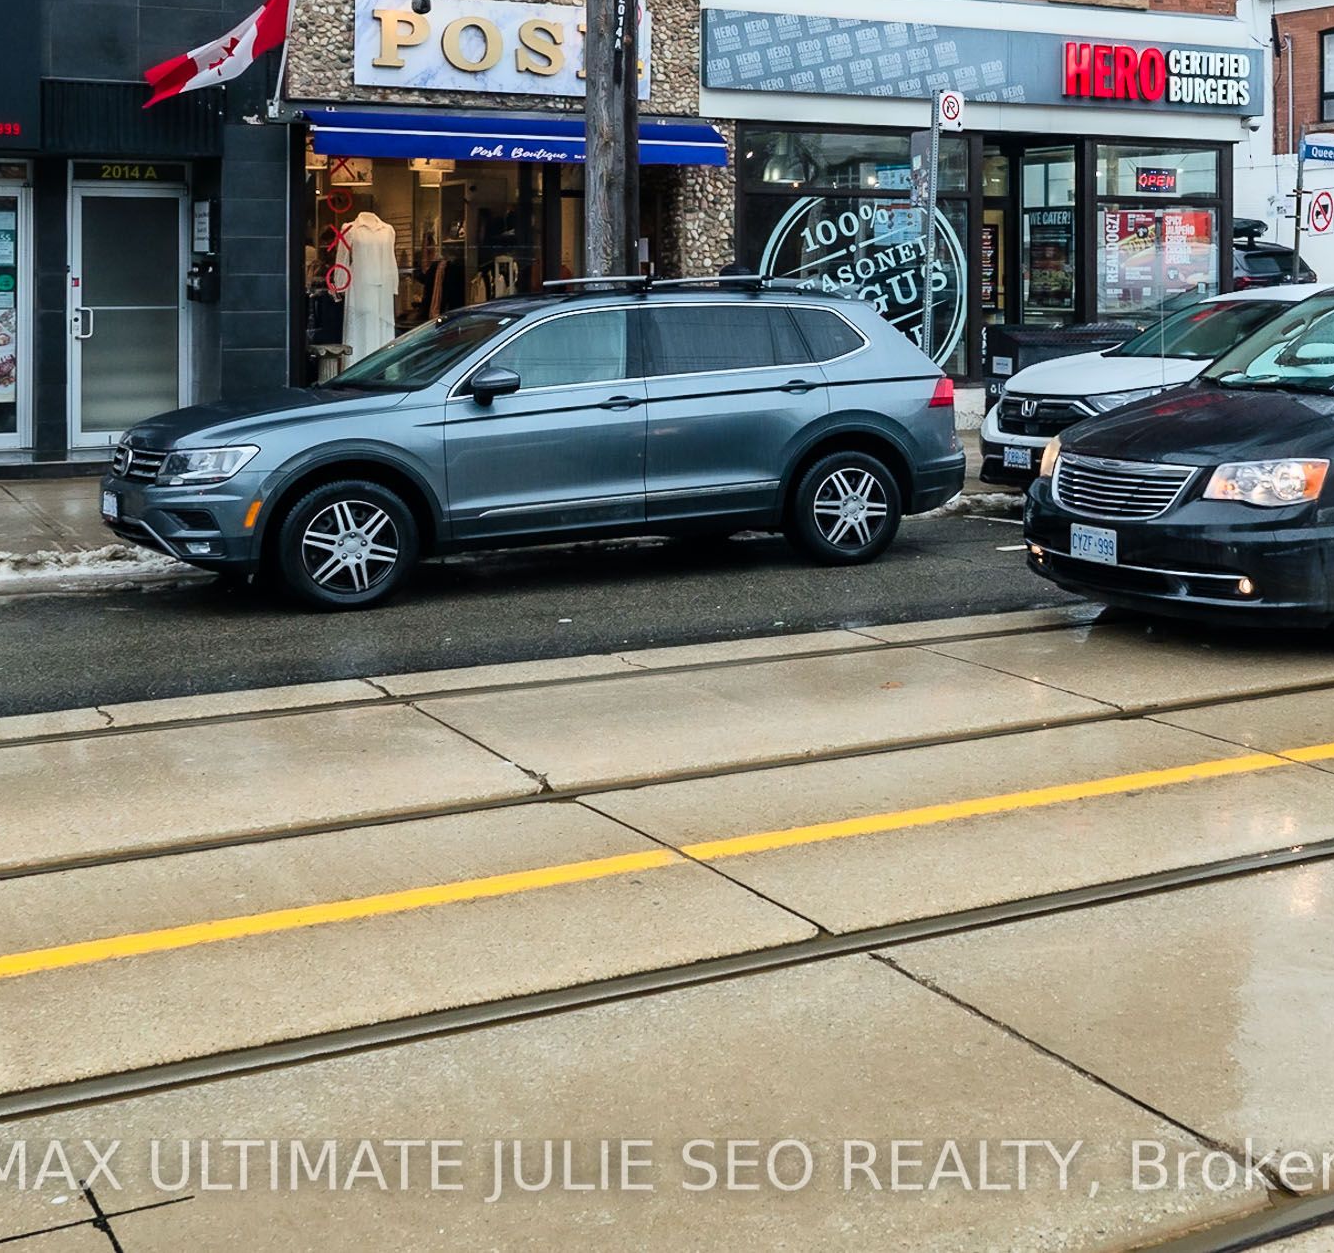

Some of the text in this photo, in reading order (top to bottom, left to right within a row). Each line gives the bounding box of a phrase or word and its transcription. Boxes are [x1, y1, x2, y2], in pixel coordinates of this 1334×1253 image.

[713, 25, 738, 40] HERO
[744, 19, 769, 33] HERO
[826, 33, 850, 48] HERO
[855, 28, 878, 41] HERO
[767, 45, 791, 60] HERO
[796, 39, 821, 54] HERO
[934, 41, 957, 54] HERO
[736, 51, 760, 66] HERO
[877, 52, 901, 66] HERO
[906, 47, 929, 61] HERO
[849, 59, 873, 72] HERO
[981, 60, 1003, 74] HERO
[1168, 49, 1251, 78] CERTIFIED
[790, 71, 814, 85] HERO
[820, 65, 843, 79] HERO
[953, 66, 976, 79] HERO
[1062, 42, 1166, 101] HERO
[898, 78, 921, 92] HERO
[926, 72, 949, 86] HERO
[1002, 85, 1024, 98] HERO
[1168, 76, 1251, 106] BURGERS
[470, 145, 503, 158] Posh
[511, 147, 567, 161] Boutique
[101, 165, 157, 179] 2014 A
[1138, 173, 1175, 188] OPEN
[1042, 210, 1071, 225] CATER!
[800, 202, 889, 252] 100%
